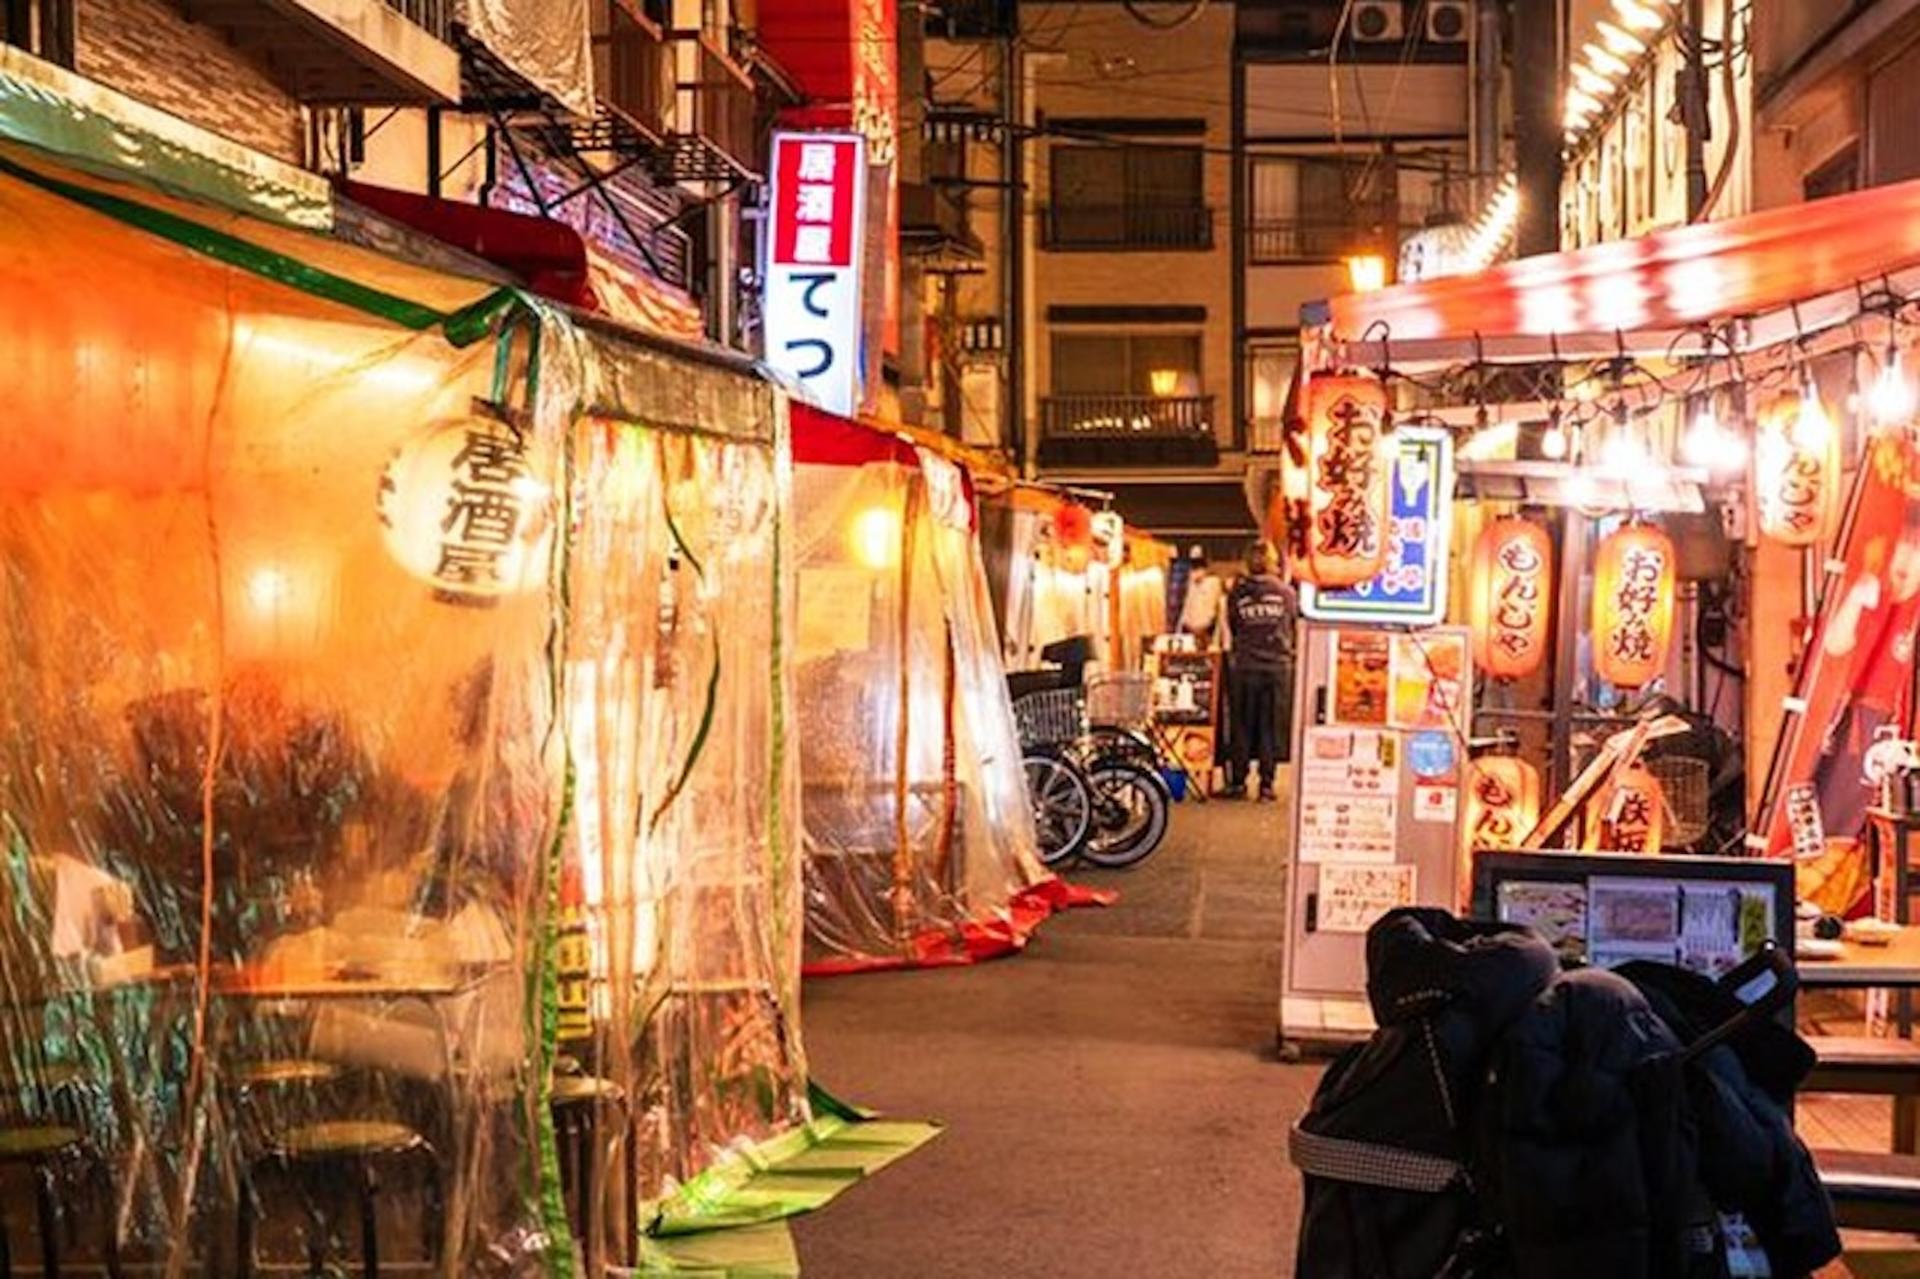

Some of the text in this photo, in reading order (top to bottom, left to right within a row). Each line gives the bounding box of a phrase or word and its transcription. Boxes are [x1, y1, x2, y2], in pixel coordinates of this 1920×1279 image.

[793, 142, 836, 264] 居酒屋
[785, 272, 837, 379] てつ
[434, 429, 529, 587] 居酒屋
[1318, 400, 1377, 557] お好み焼
[1612, 551, 1661, 660] お好み焼
